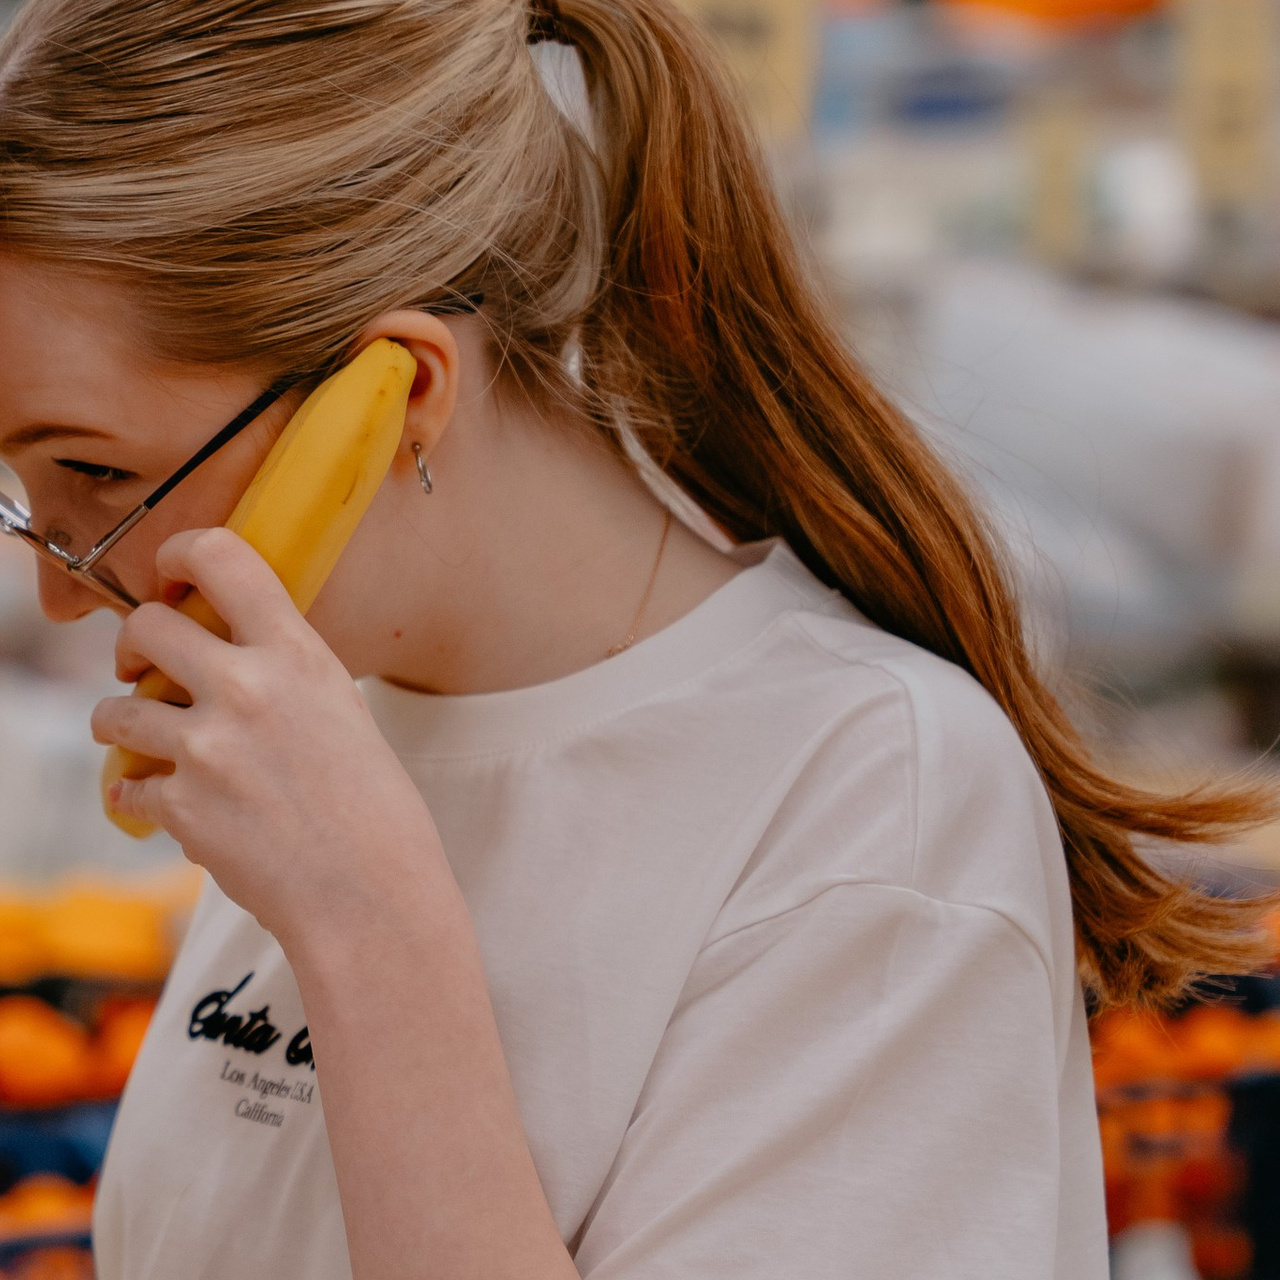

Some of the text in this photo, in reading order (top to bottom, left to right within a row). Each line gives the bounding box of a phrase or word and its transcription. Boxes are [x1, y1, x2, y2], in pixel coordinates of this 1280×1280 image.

[220, 1060, 245, 1086] Los
[247, 1073, 291, 1099] Angeles
[235, 1098, 284, 1127] California
